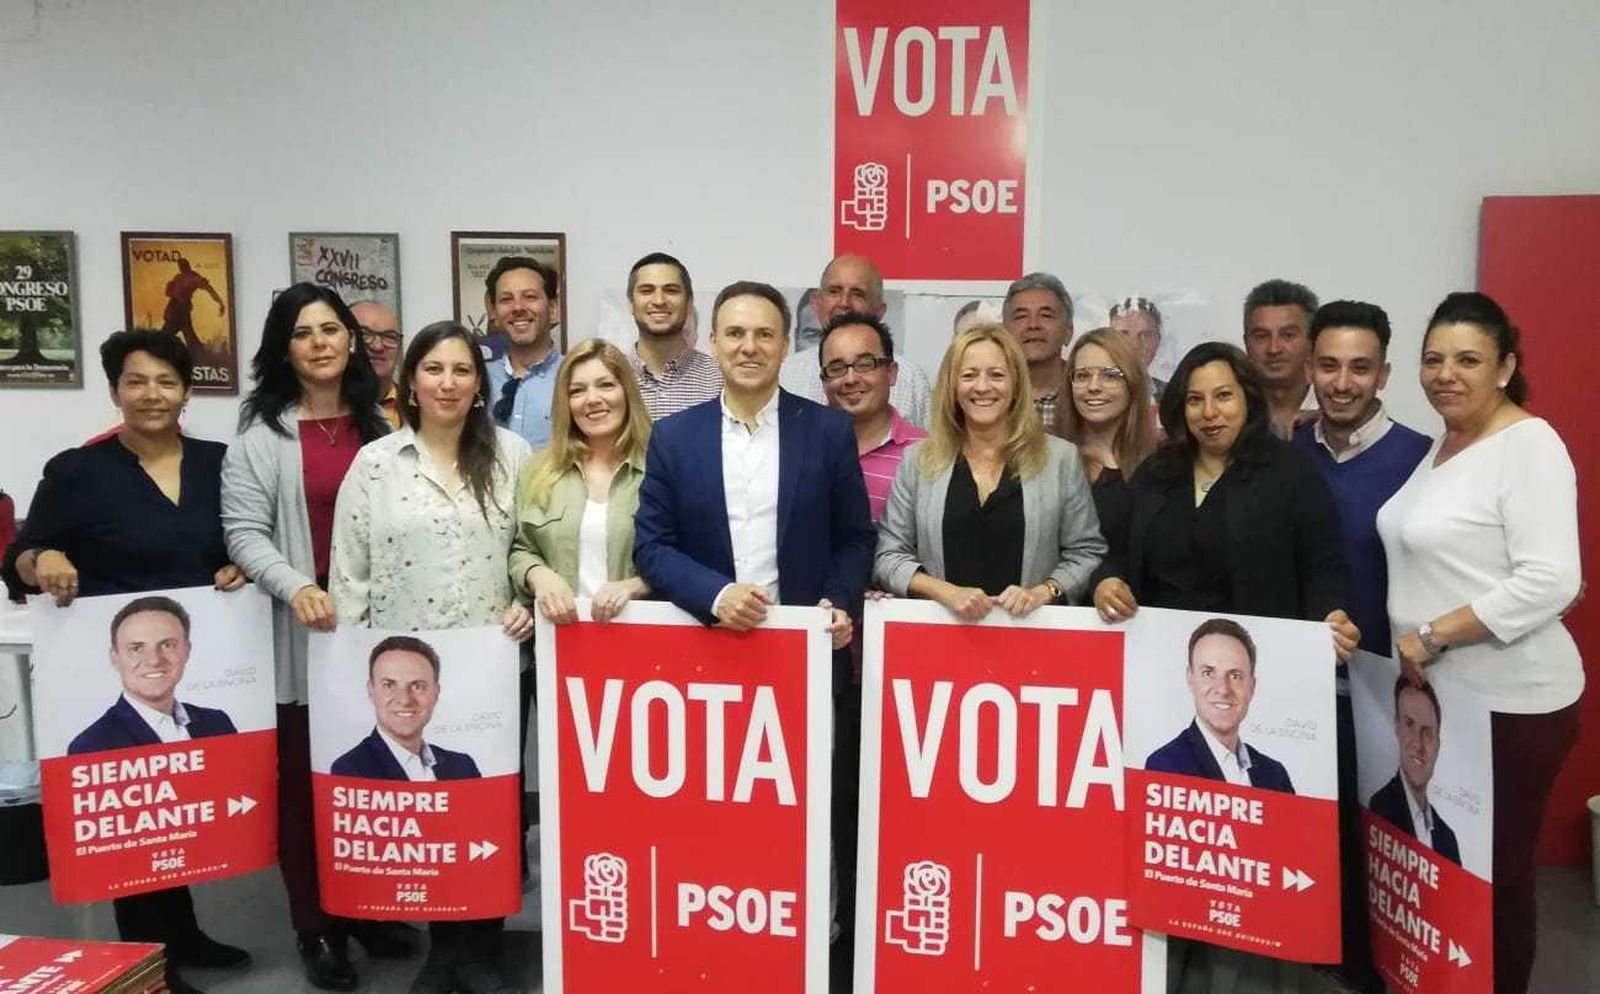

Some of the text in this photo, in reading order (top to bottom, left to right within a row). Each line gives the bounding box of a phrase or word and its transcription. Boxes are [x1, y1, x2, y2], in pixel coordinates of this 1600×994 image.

[843, 25, 1021, 117] VOTA
[926, 179, 1018, 214] PSOE
[14, 265, 33, 280] 29
[132, 249, 182, 262] VOTAD
[317, 245, 359, 270] XXVII
[315, 269, 388, 290] CONGRESO
[5, 296, 48, 312] PSOE
[565, 676, 798, 806] VOTA
[892, 678, 1125, 812] VOTA
[71, 750, 205, 789] SIEMPRE
[72, 780, 178, 815] HACIA
[332, 786, 449, 813] SIEMPRE
[1146, 783, 1264, 825] SIEMPRE
[74, 800, 216, 842] DELANTE
[332, 812, 422, 838] HACIA
[1145, 812, 1238, 849] HACIA
[139, 835, 168, 847] Santa
[333, 837, 456, 863] DELANTE
[1368, 824, 1439, 891] SIEMPRE
[151, 856, 186, 872] PSOE
[385, 867, 411, 876] Santa
[1144, 840, 1271, 887] DELANTE
[1367, 853, 1421, 909] HACIA
[396, 891, 428, 902] PSOE
[1198, 878, 1226, 892] Santa
[677, 882, 797, 937] PSOE
[1004, 890, 1133, 946] PSOE
[1209, 909, 1241, 927] PSOE
[1368, 882, 1441, 954] DELANTE
